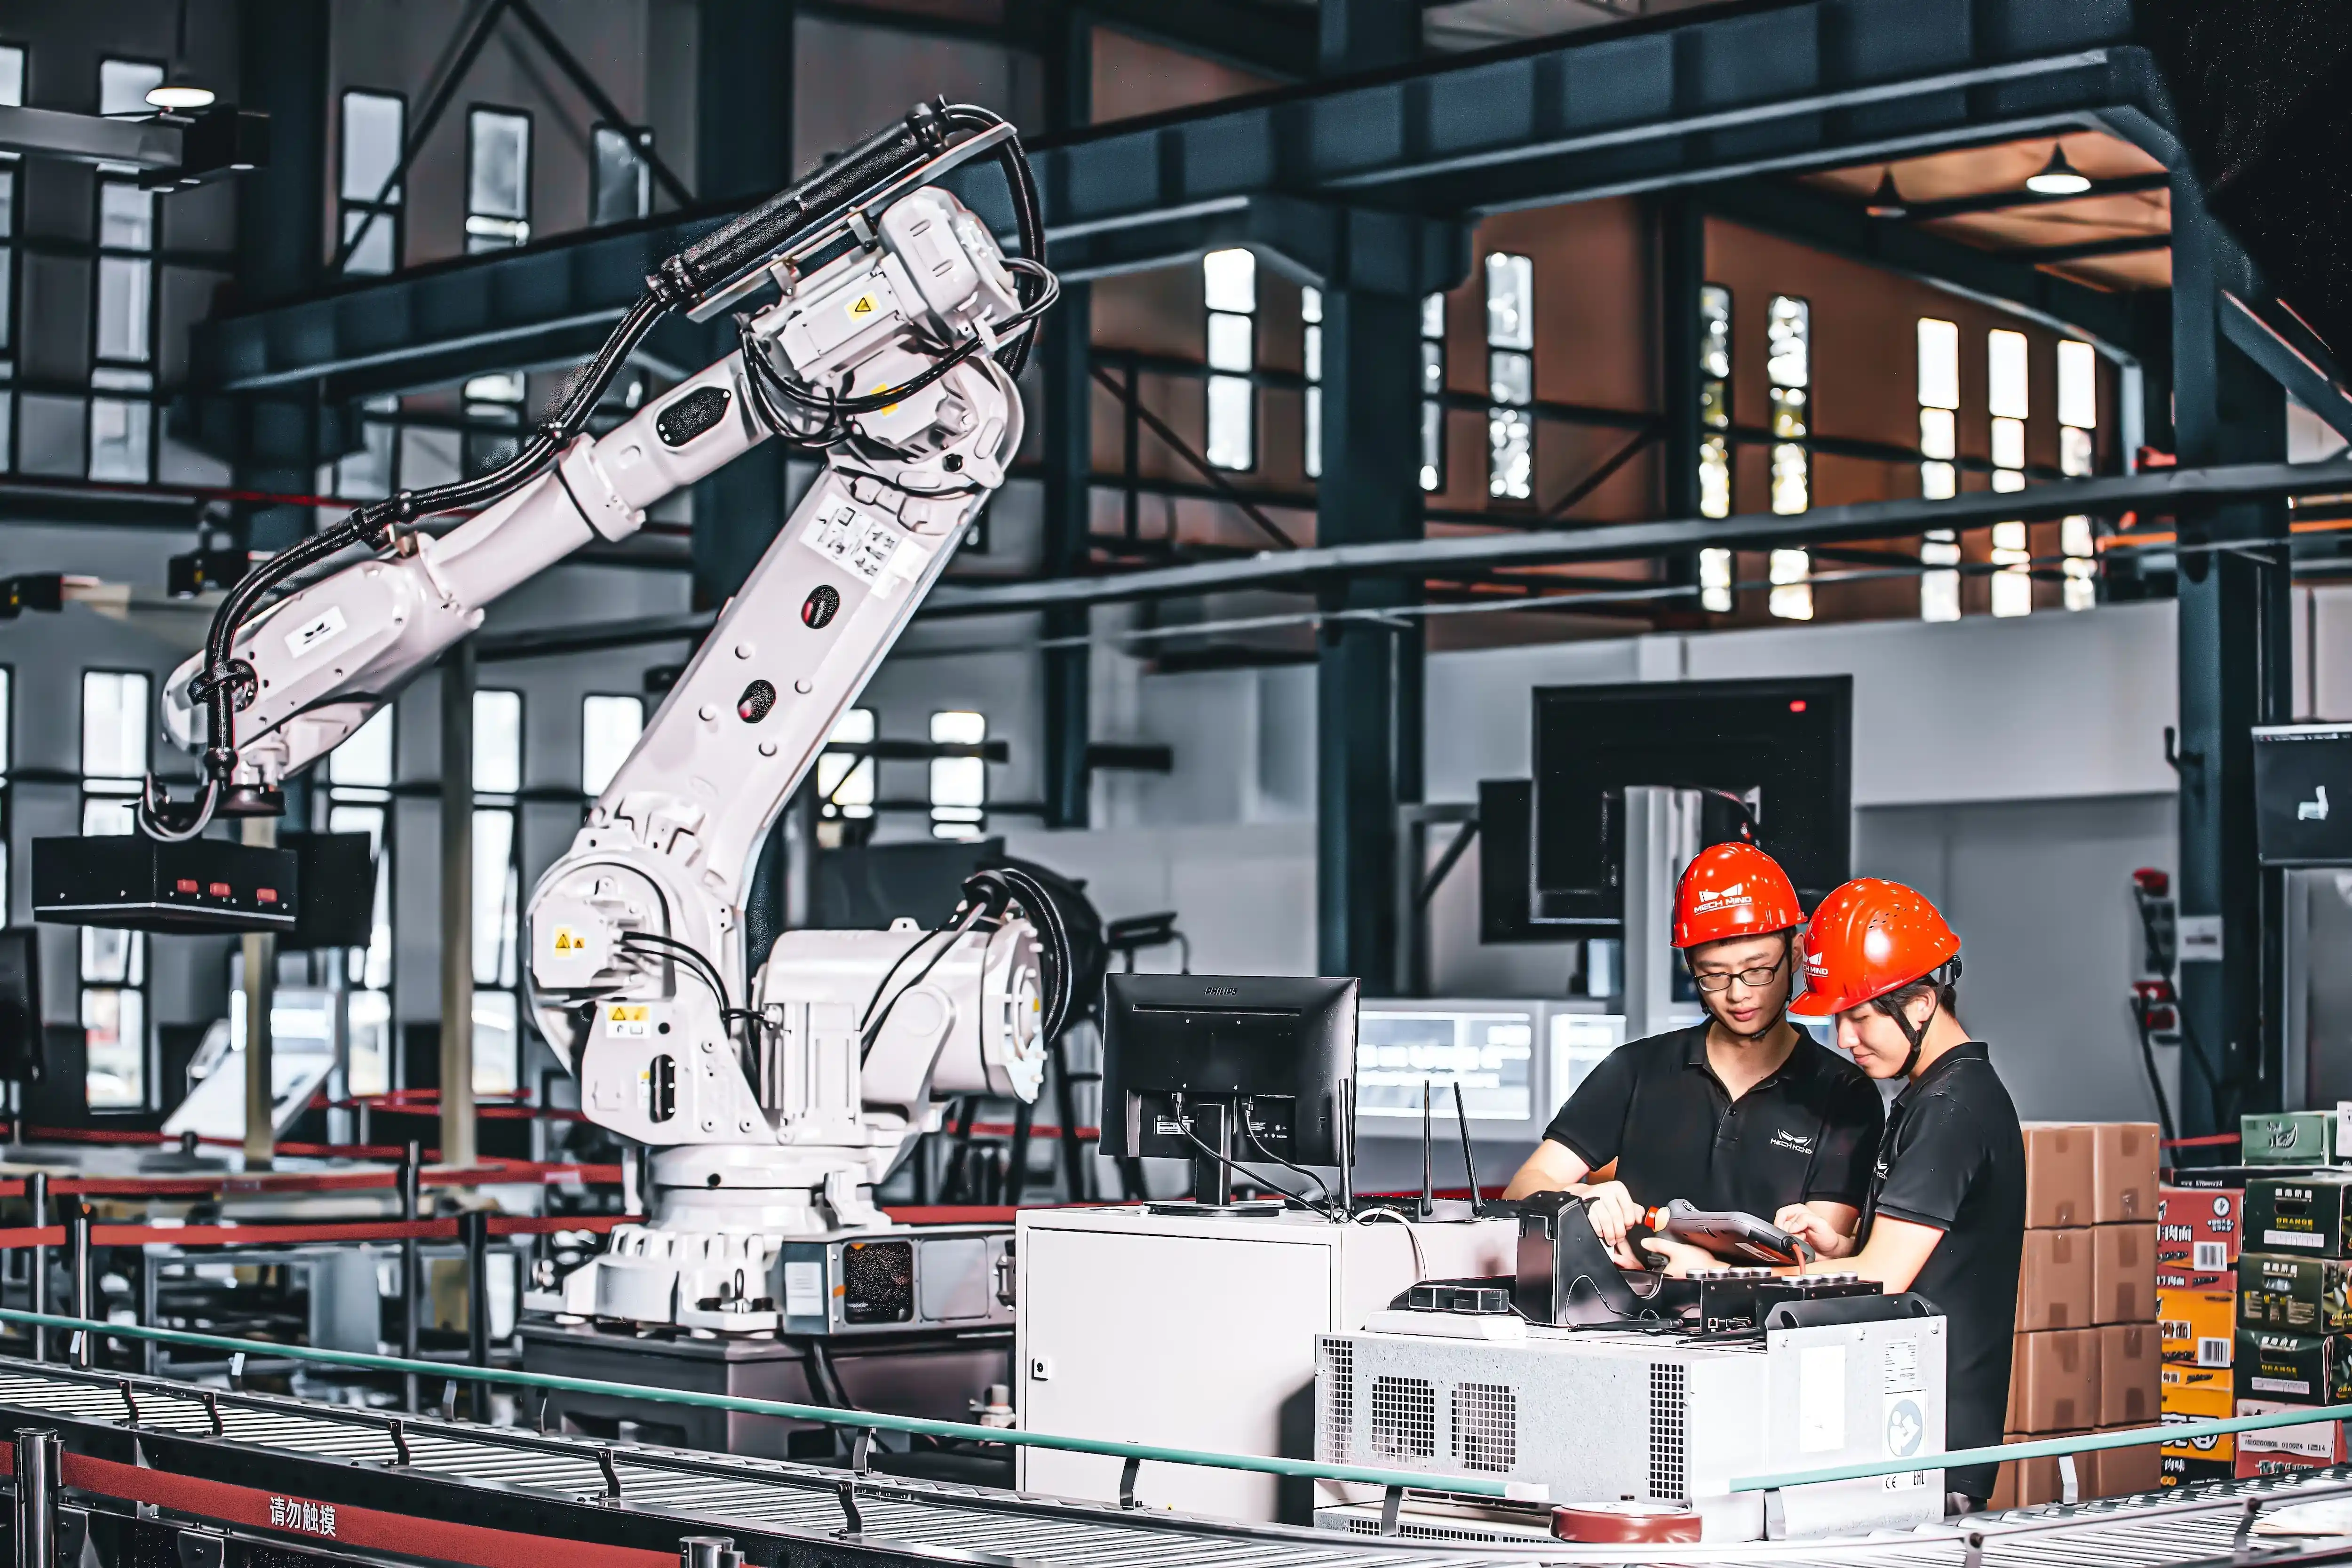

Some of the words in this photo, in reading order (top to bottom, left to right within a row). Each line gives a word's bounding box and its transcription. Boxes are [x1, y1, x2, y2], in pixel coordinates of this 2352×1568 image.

[1693, 900, 1723, 914] MECH
[1725, 896, 1752, 905] MIND
[1810, 966, 1828, 975] MIND
[1204, 987, 1238, 995] PHILIPS
[1770, 1138, 1792, 1149] MECH
[1792, 1144, 1812, 1154] MIND
[1885, 1476, 1896, 1489] CE
[270, 1496, 336, 1537] 请勿触摸
